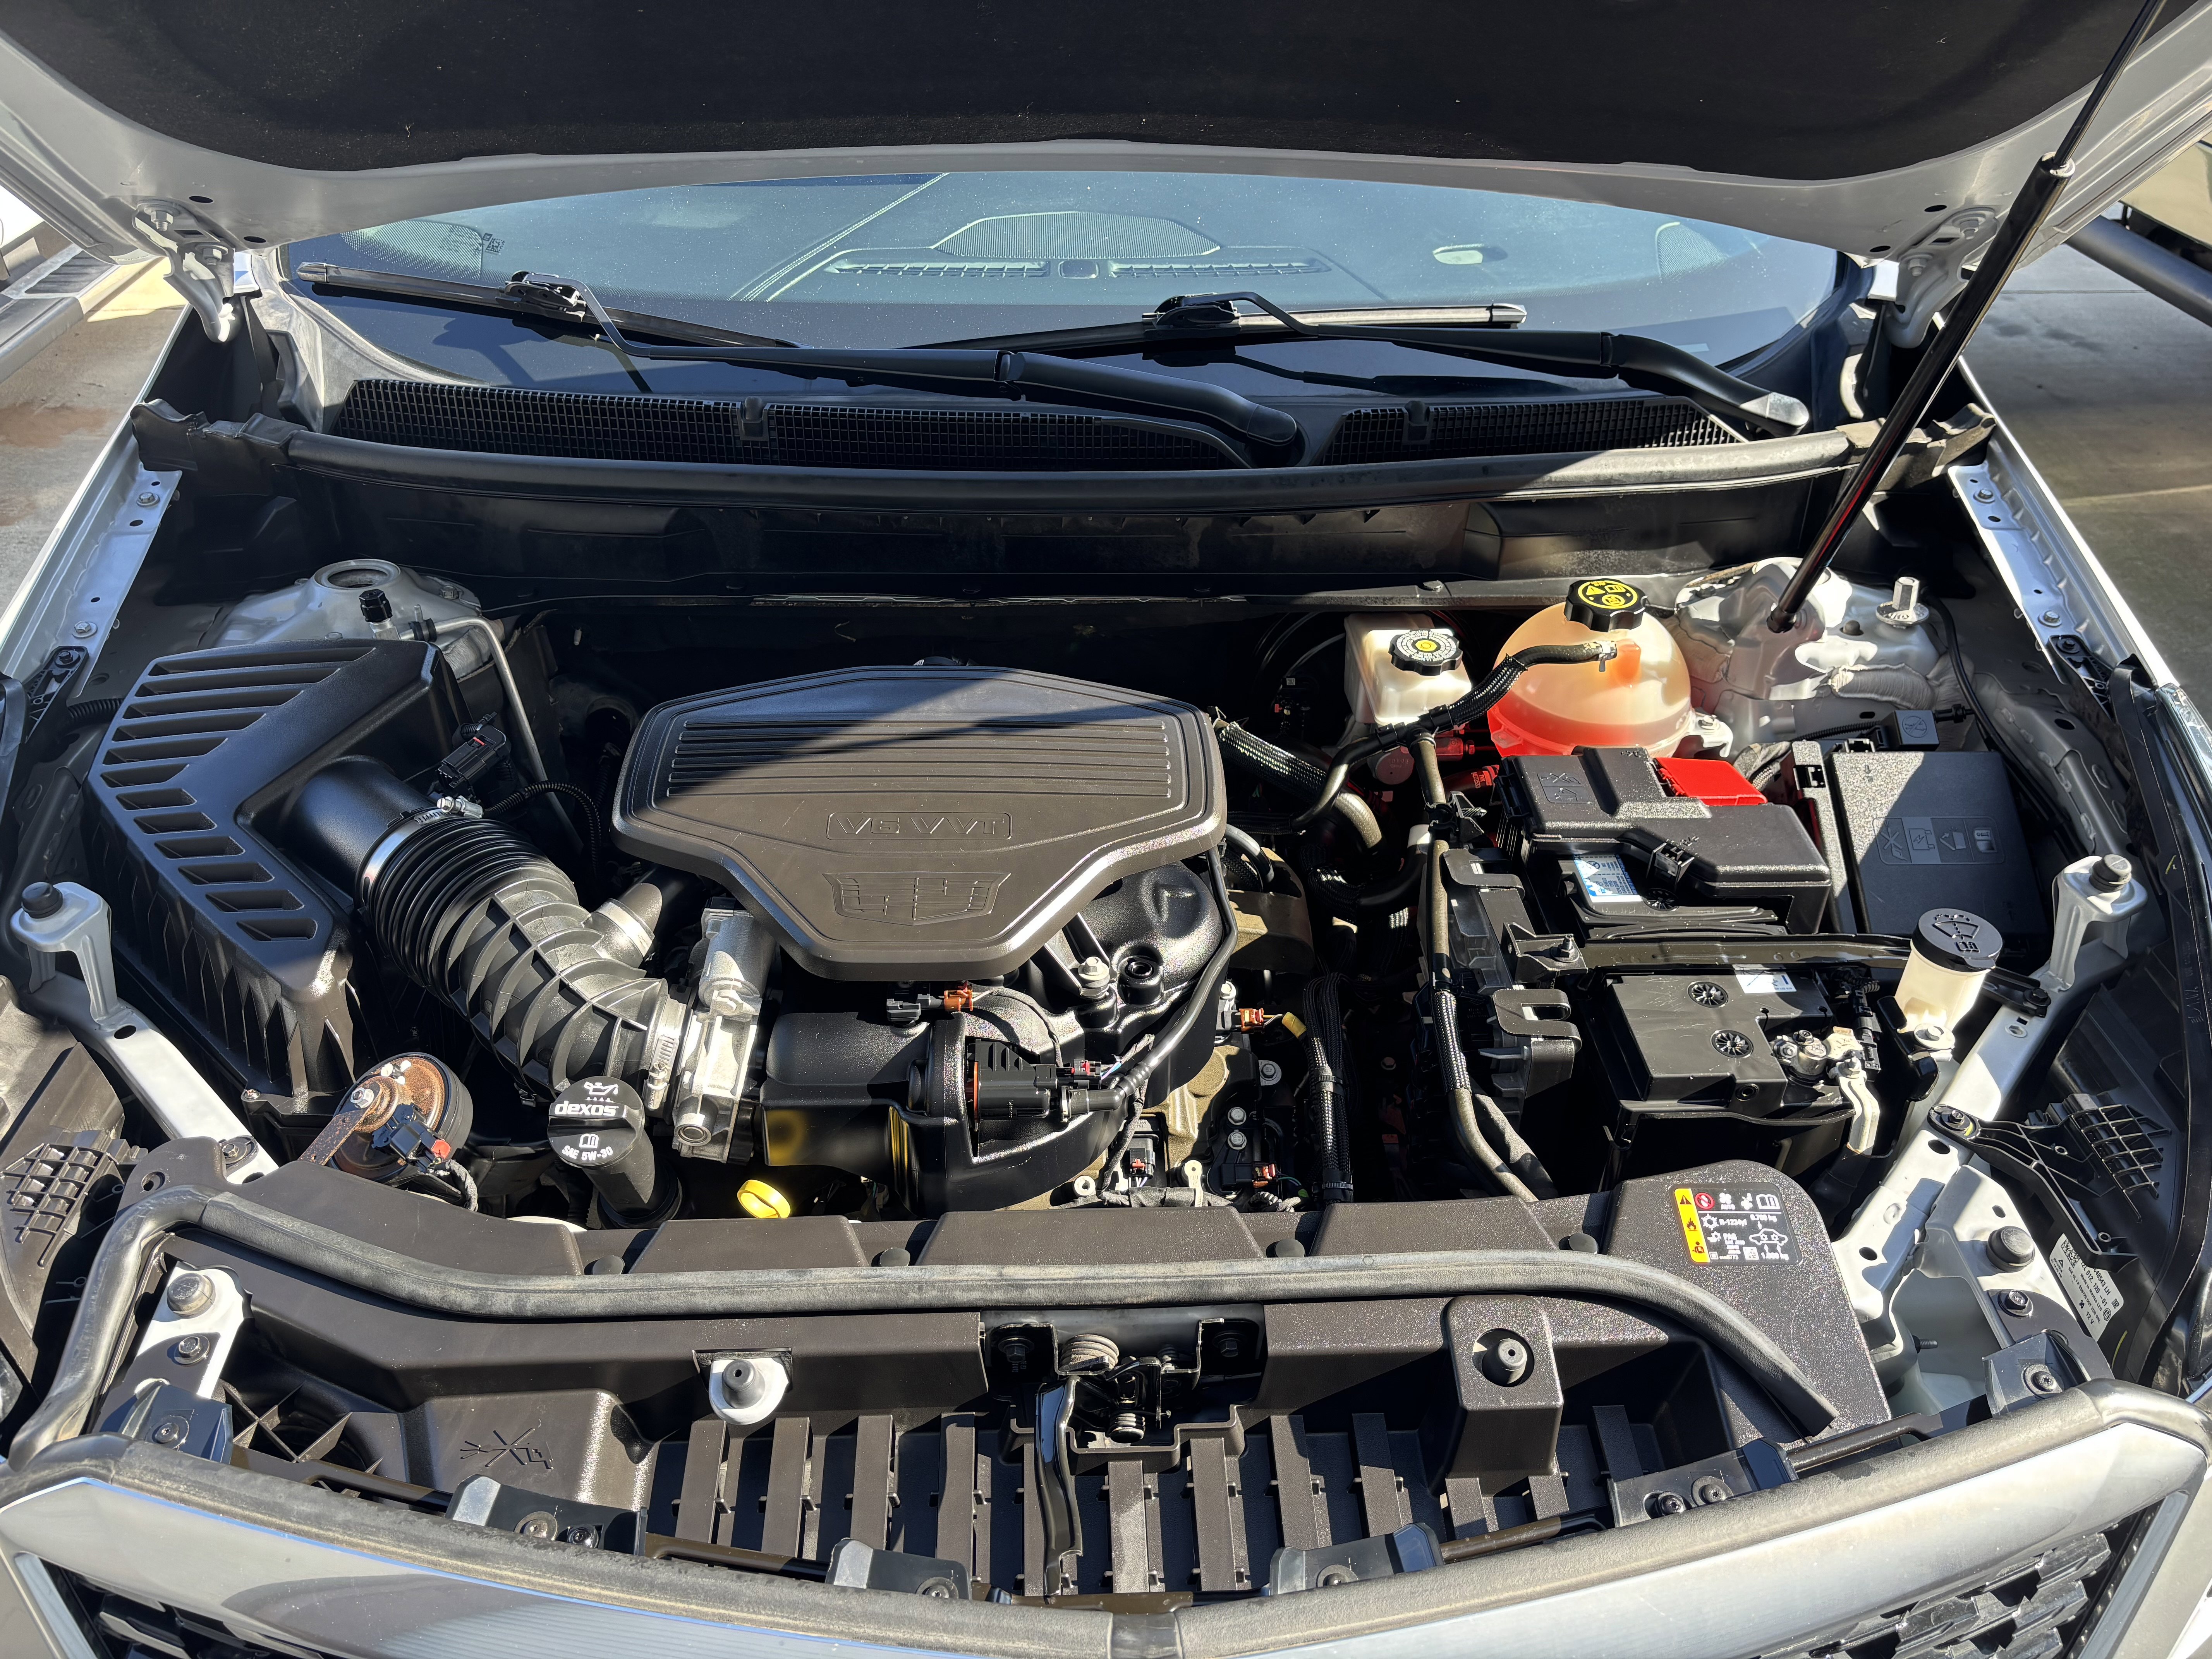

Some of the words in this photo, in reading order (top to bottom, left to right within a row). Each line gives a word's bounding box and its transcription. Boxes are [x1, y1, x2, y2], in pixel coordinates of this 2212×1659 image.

[836, 817, 900, 834] V6
[910, 817, 1005, 834] VVT
[554, 1100, 617, 1116] dexos
[562, 1145, 579, 1159] SAE
[581, 1146, 613, 1161] 5W-30
[2104, 1286, 2111, 1296] LH
